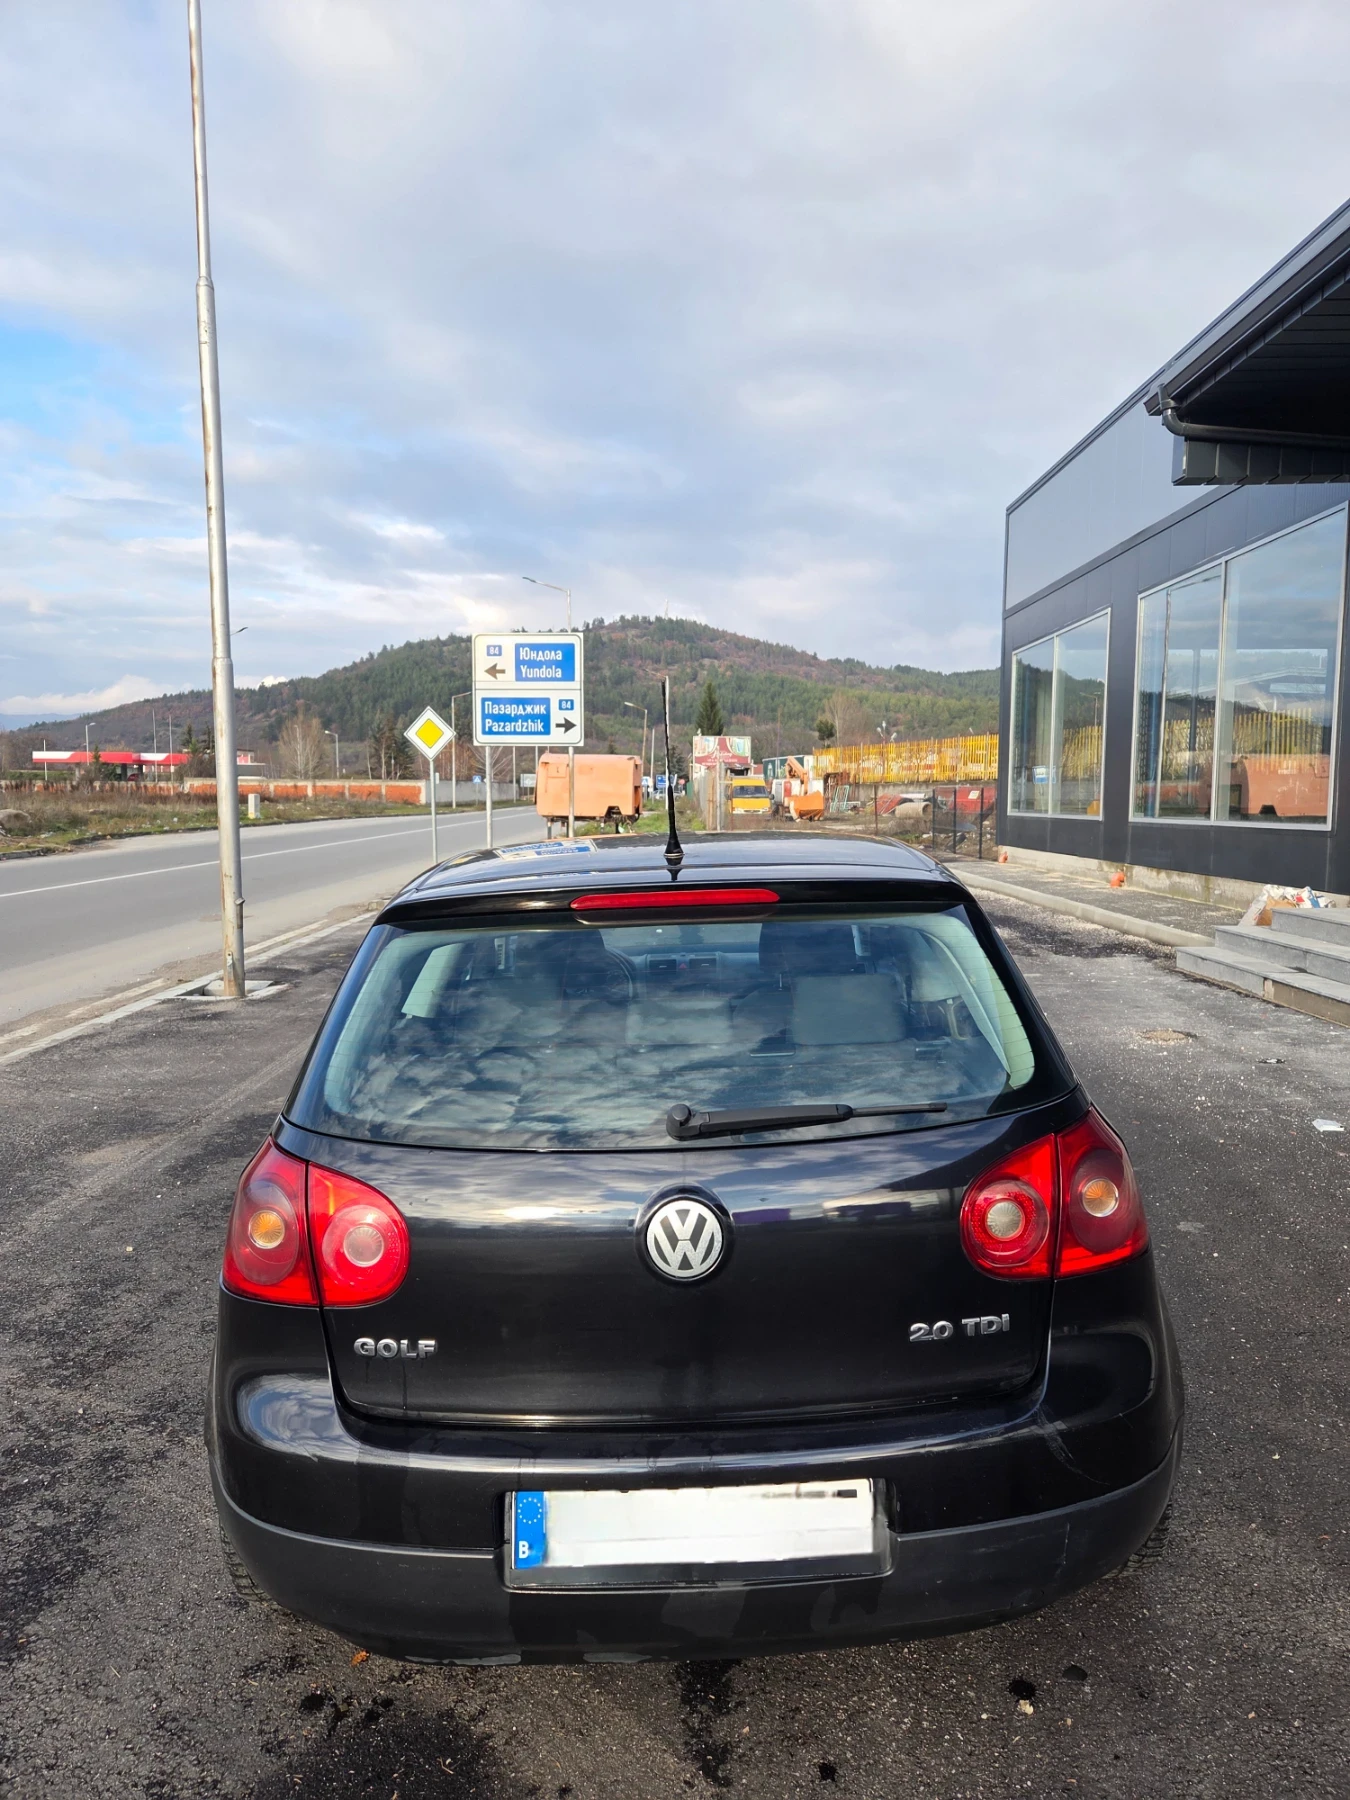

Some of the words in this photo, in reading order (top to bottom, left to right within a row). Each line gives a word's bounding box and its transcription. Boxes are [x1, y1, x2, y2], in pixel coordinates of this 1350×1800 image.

[489, 646, 499, 655] 84
[519, 647, 563, 662] Юндола
[520, 665, 563, 678] Yundola
[484, 701, 547, 717] Пазарджик
[561, 700, 572, 709] 84
[485, 719, 544, 732] Pazardzhik
[961, 1313, 1010, 1337] TDI
[353, 1337, 437, 1359] GOLF
